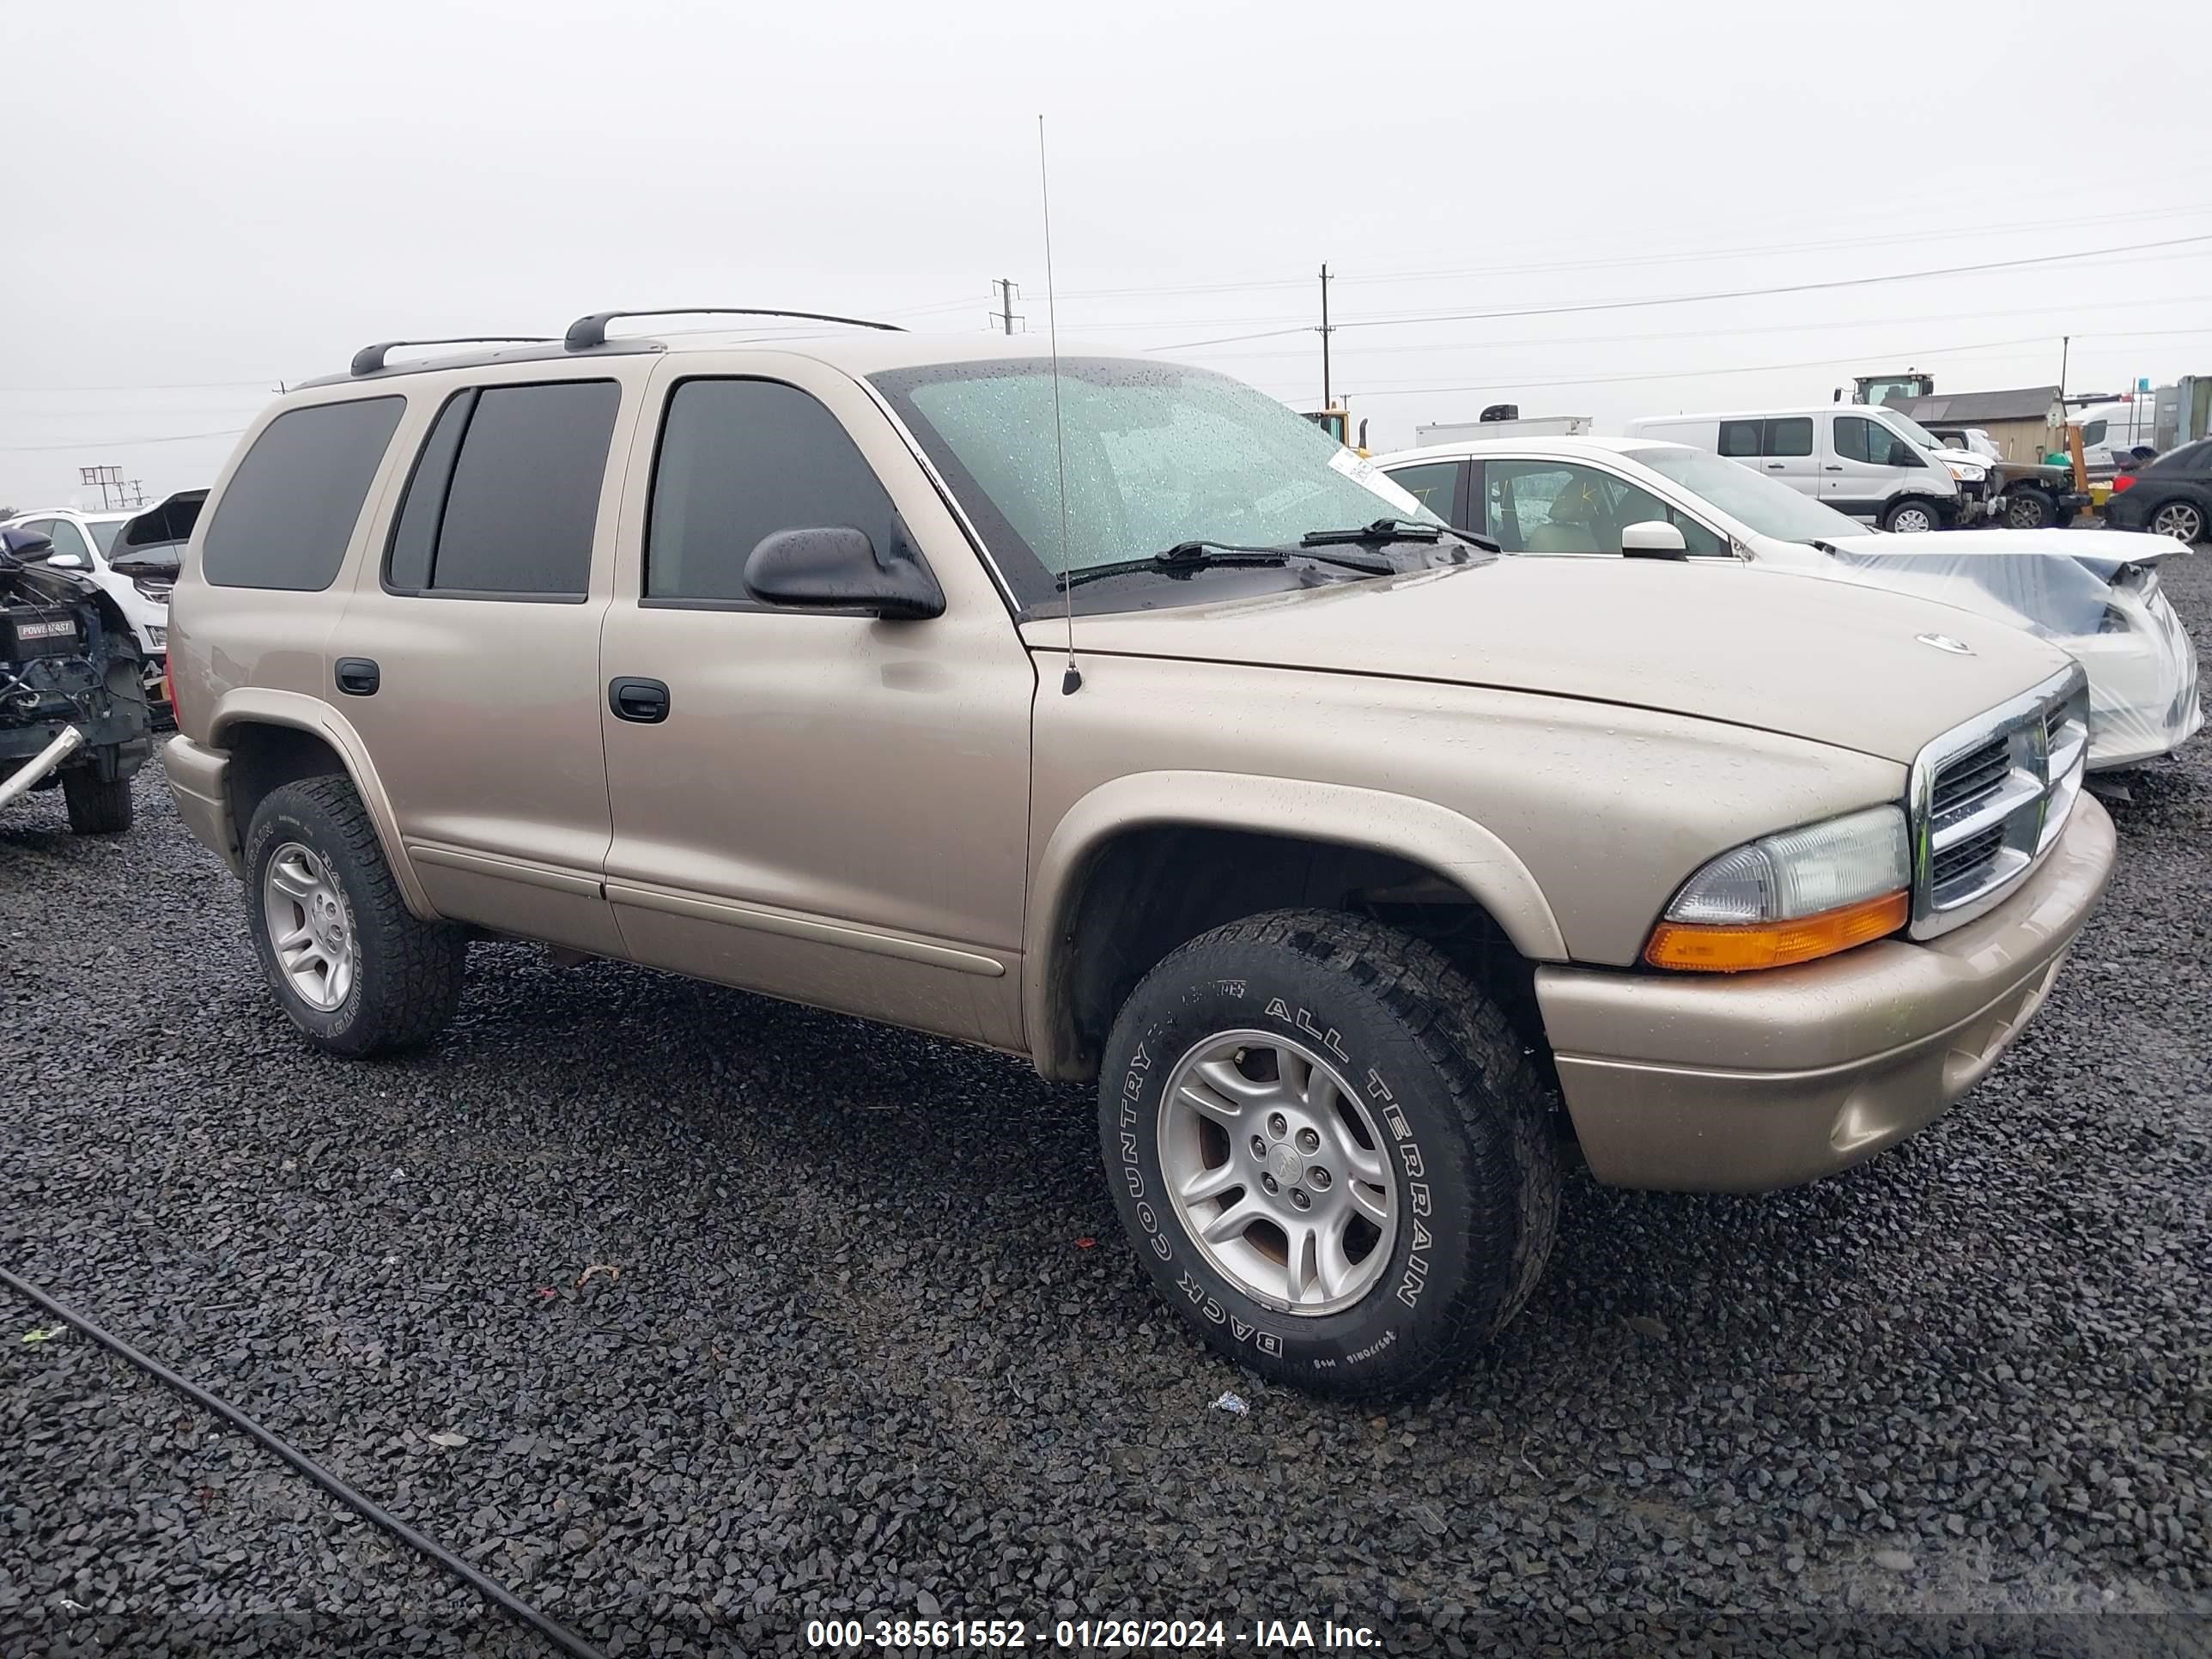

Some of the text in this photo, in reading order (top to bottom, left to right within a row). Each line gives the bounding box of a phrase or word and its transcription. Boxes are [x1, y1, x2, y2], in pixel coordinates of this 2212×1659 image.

[1120, 1041, 1283, 1358] BACK COUNTRY
[1265, 997, 1432, 1309] ALL TERRAIN
